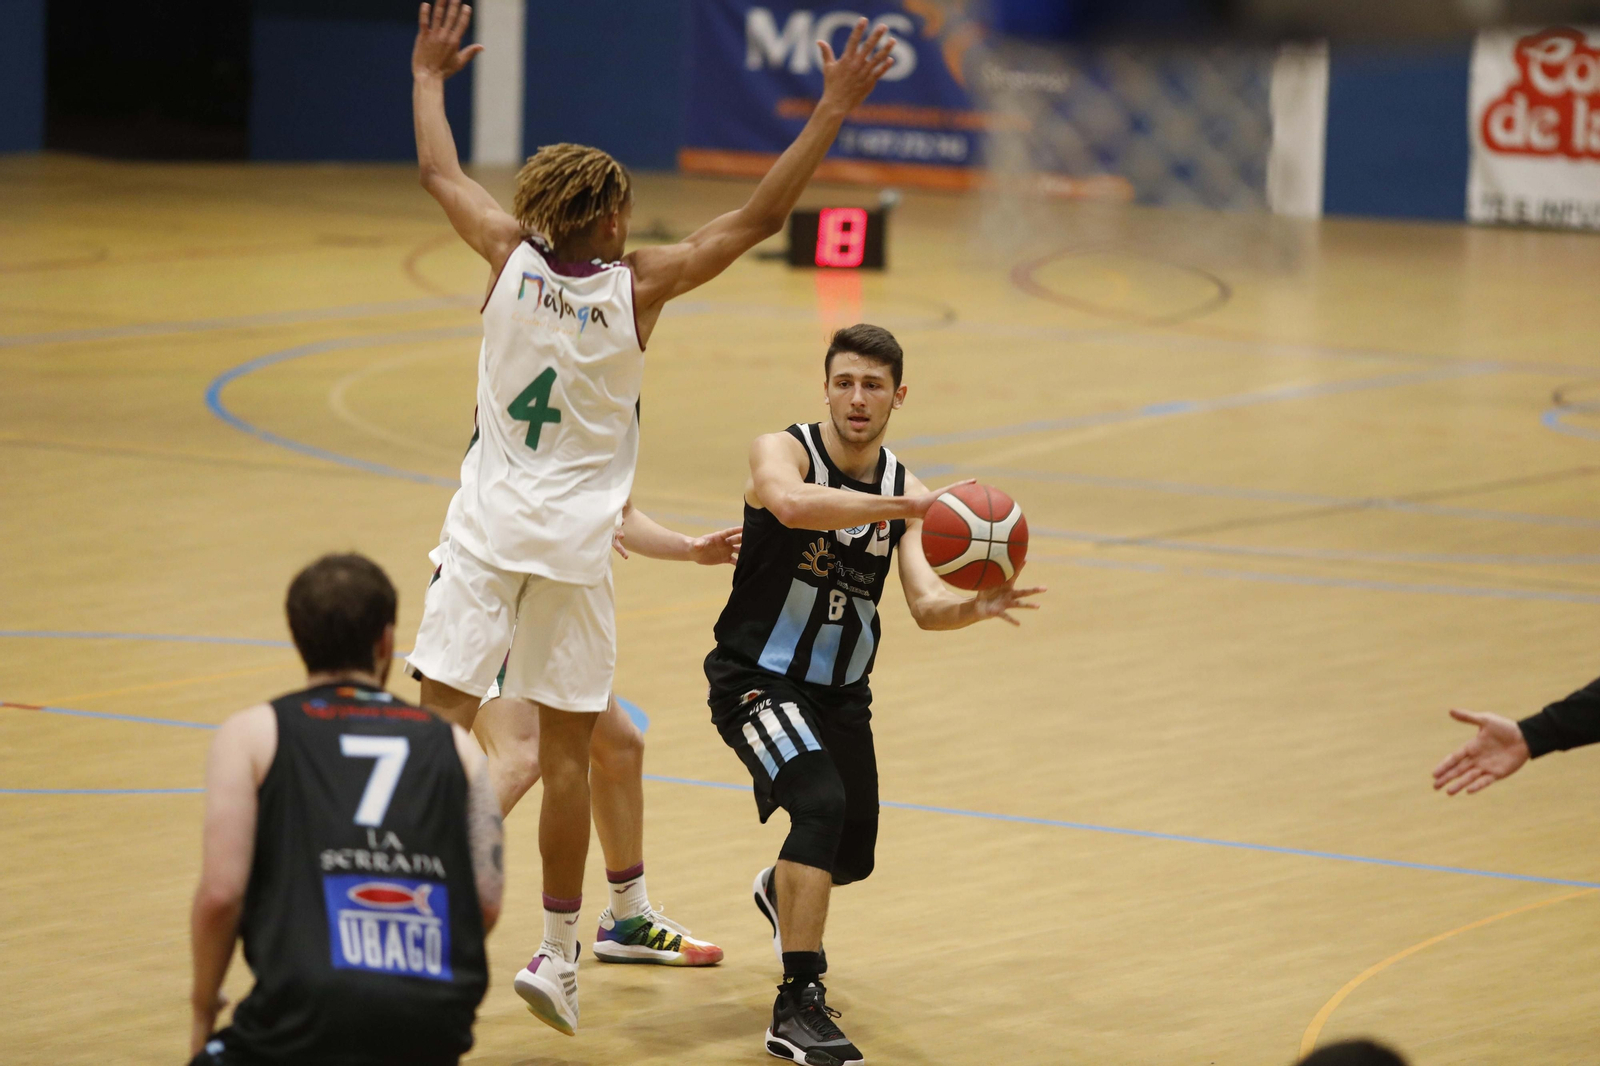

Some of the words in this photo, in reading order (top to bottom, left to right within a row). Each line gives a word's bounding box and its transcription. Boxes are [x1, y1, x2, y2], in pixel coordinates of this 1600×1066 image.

[1522, 36, 1600, 97] Co
[1488, 91, 1560, 150] de
[815, 208, 867, 267] 8
[507, 366, 561, 451] 4
[828, 589, 847, 620] 8
[339, 734, 410, 827] 7
[339, 911, 443, 976] UBAGO
